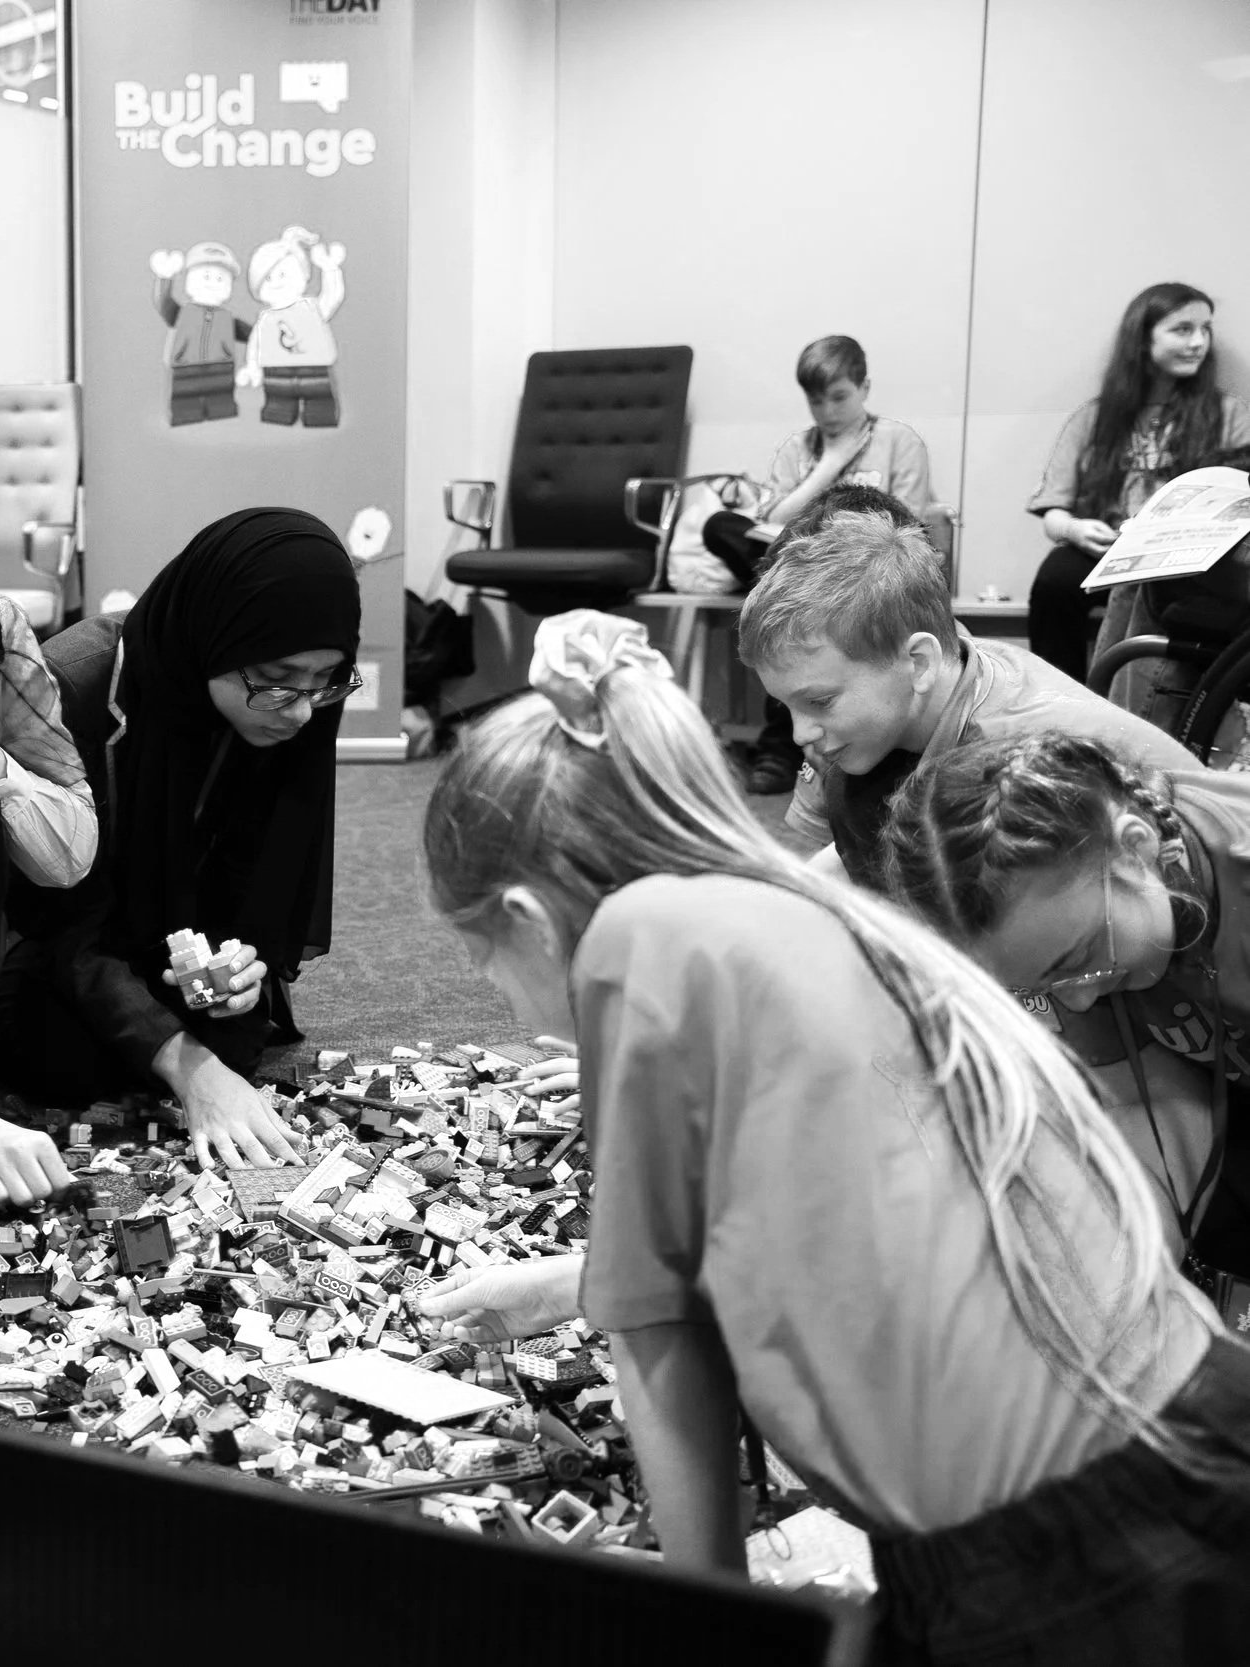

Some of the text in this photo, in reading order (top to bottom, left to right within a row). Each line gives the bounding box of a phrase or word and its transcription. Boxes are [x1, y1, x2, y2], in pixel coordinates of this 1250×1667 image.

[114, 73, 255, 128] Build
[115, 121, 377, 178] THE Change
